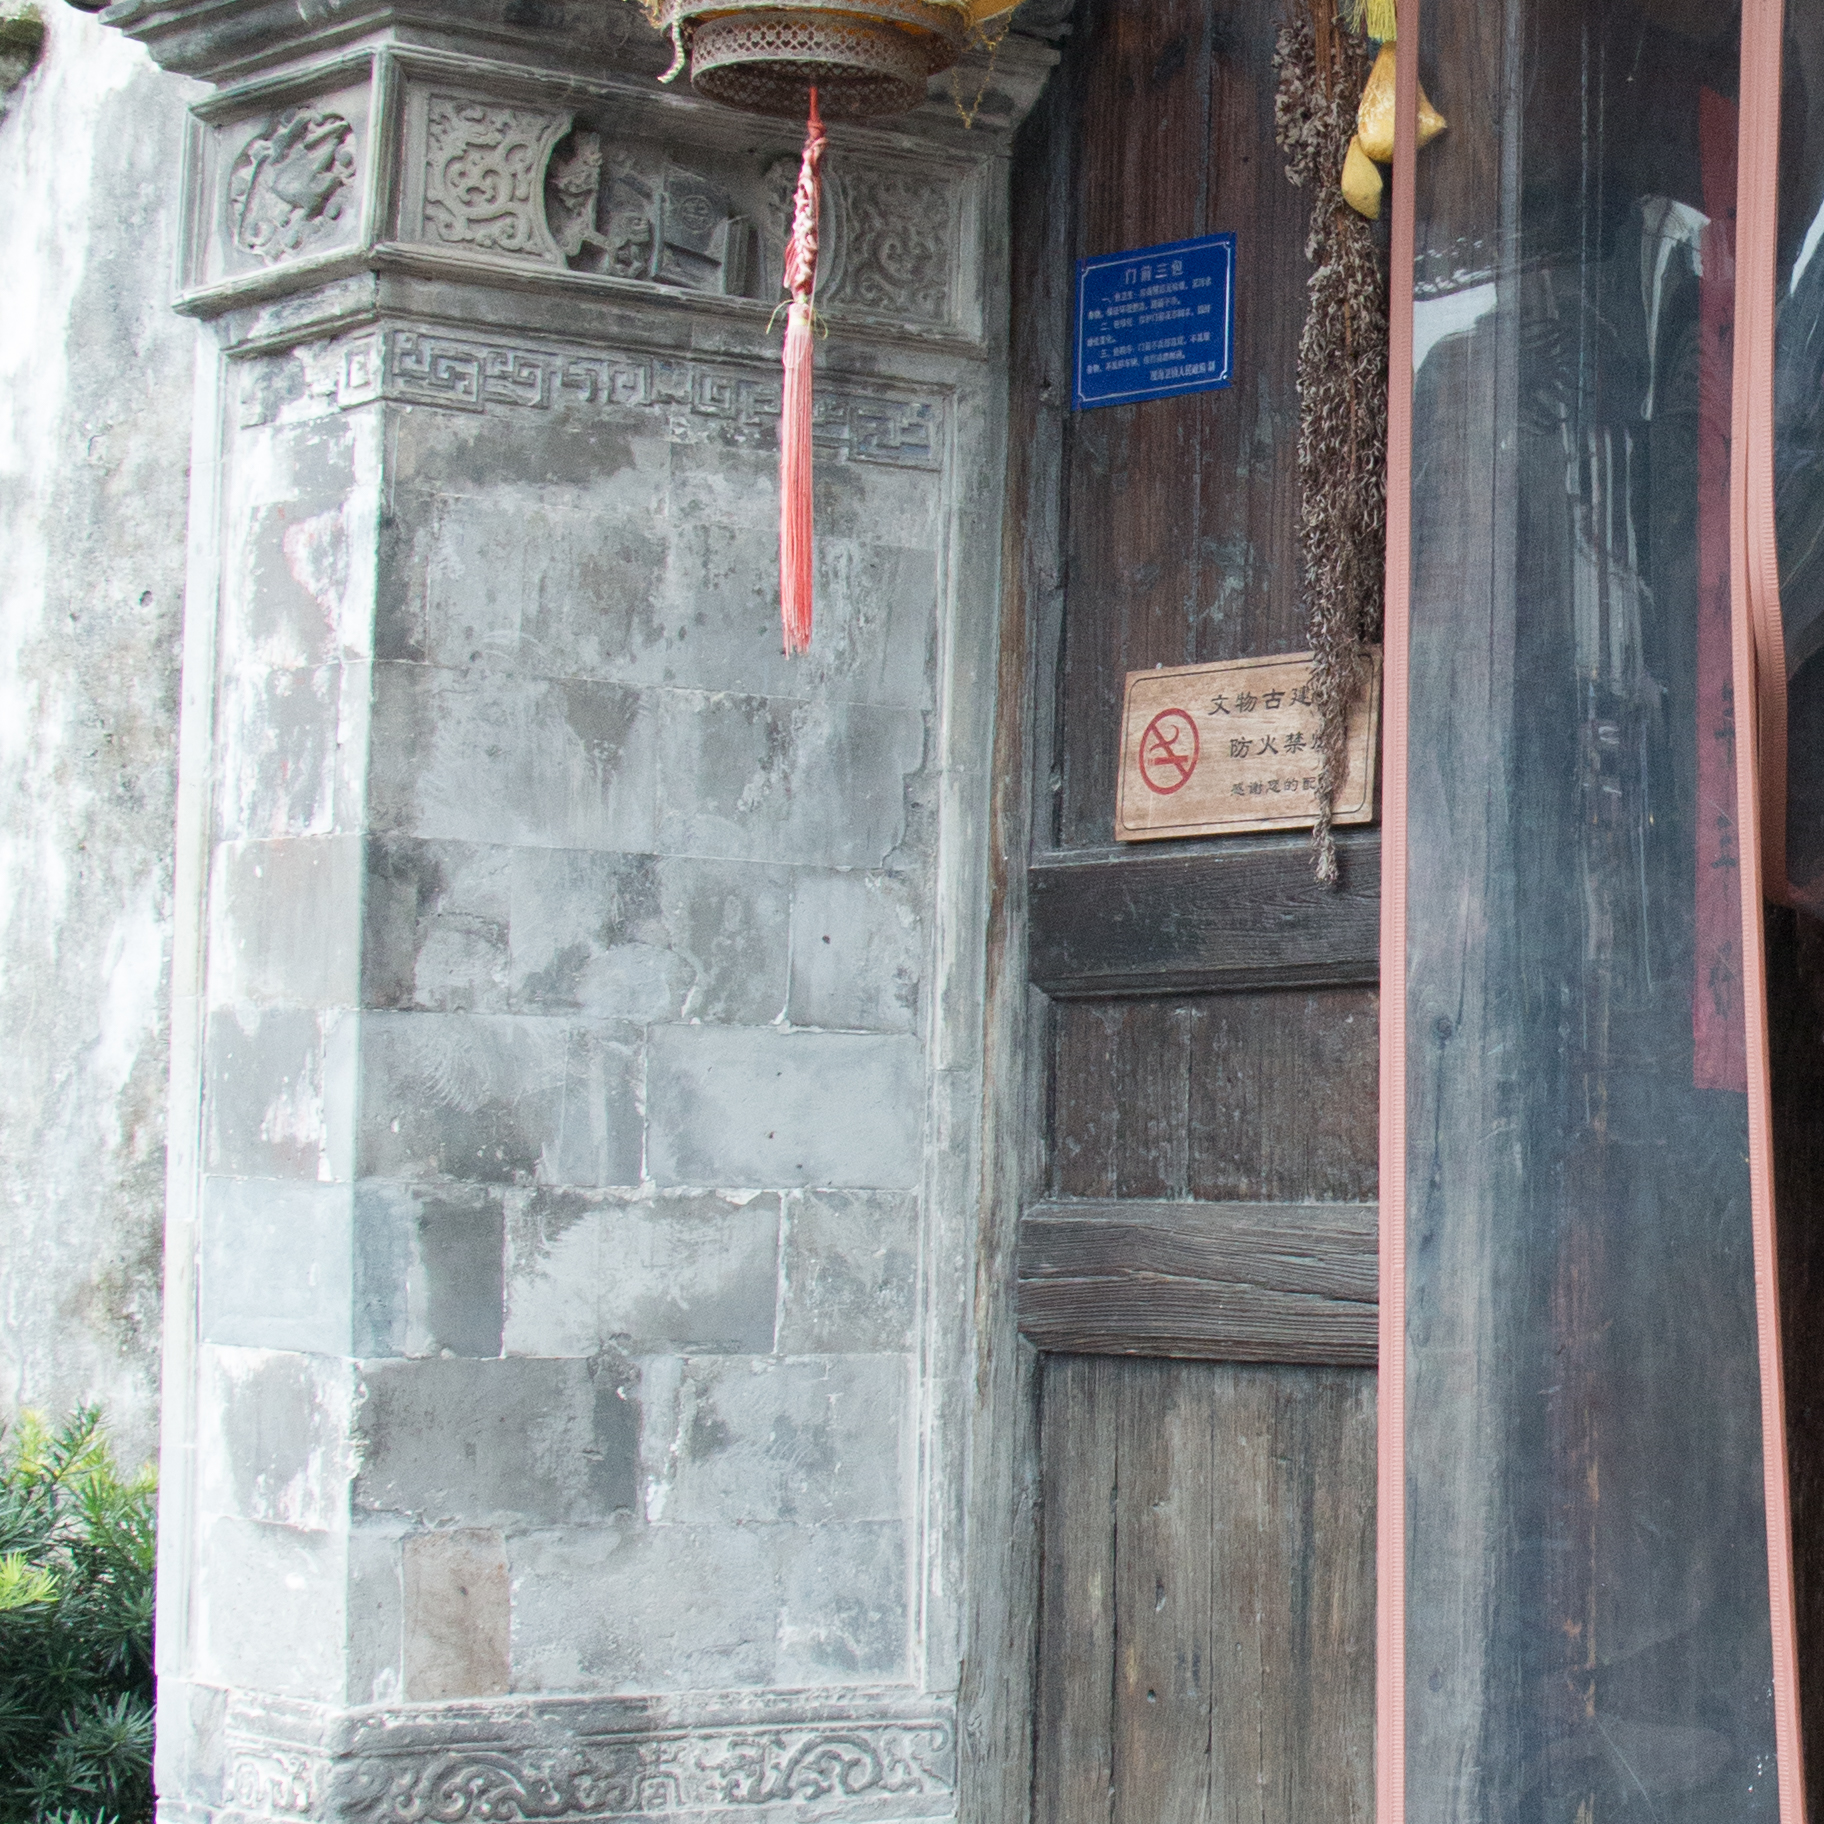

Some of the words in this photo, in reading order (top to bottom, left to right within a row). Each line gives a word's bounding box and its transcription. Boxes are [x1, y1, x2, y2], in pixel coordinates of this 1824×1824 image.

[1125, 260, 1184, 285] 门前三包
[1208, 685, 1313, 716] 文物古建
[1230, 776, 1317, 797] 感谢您的配
